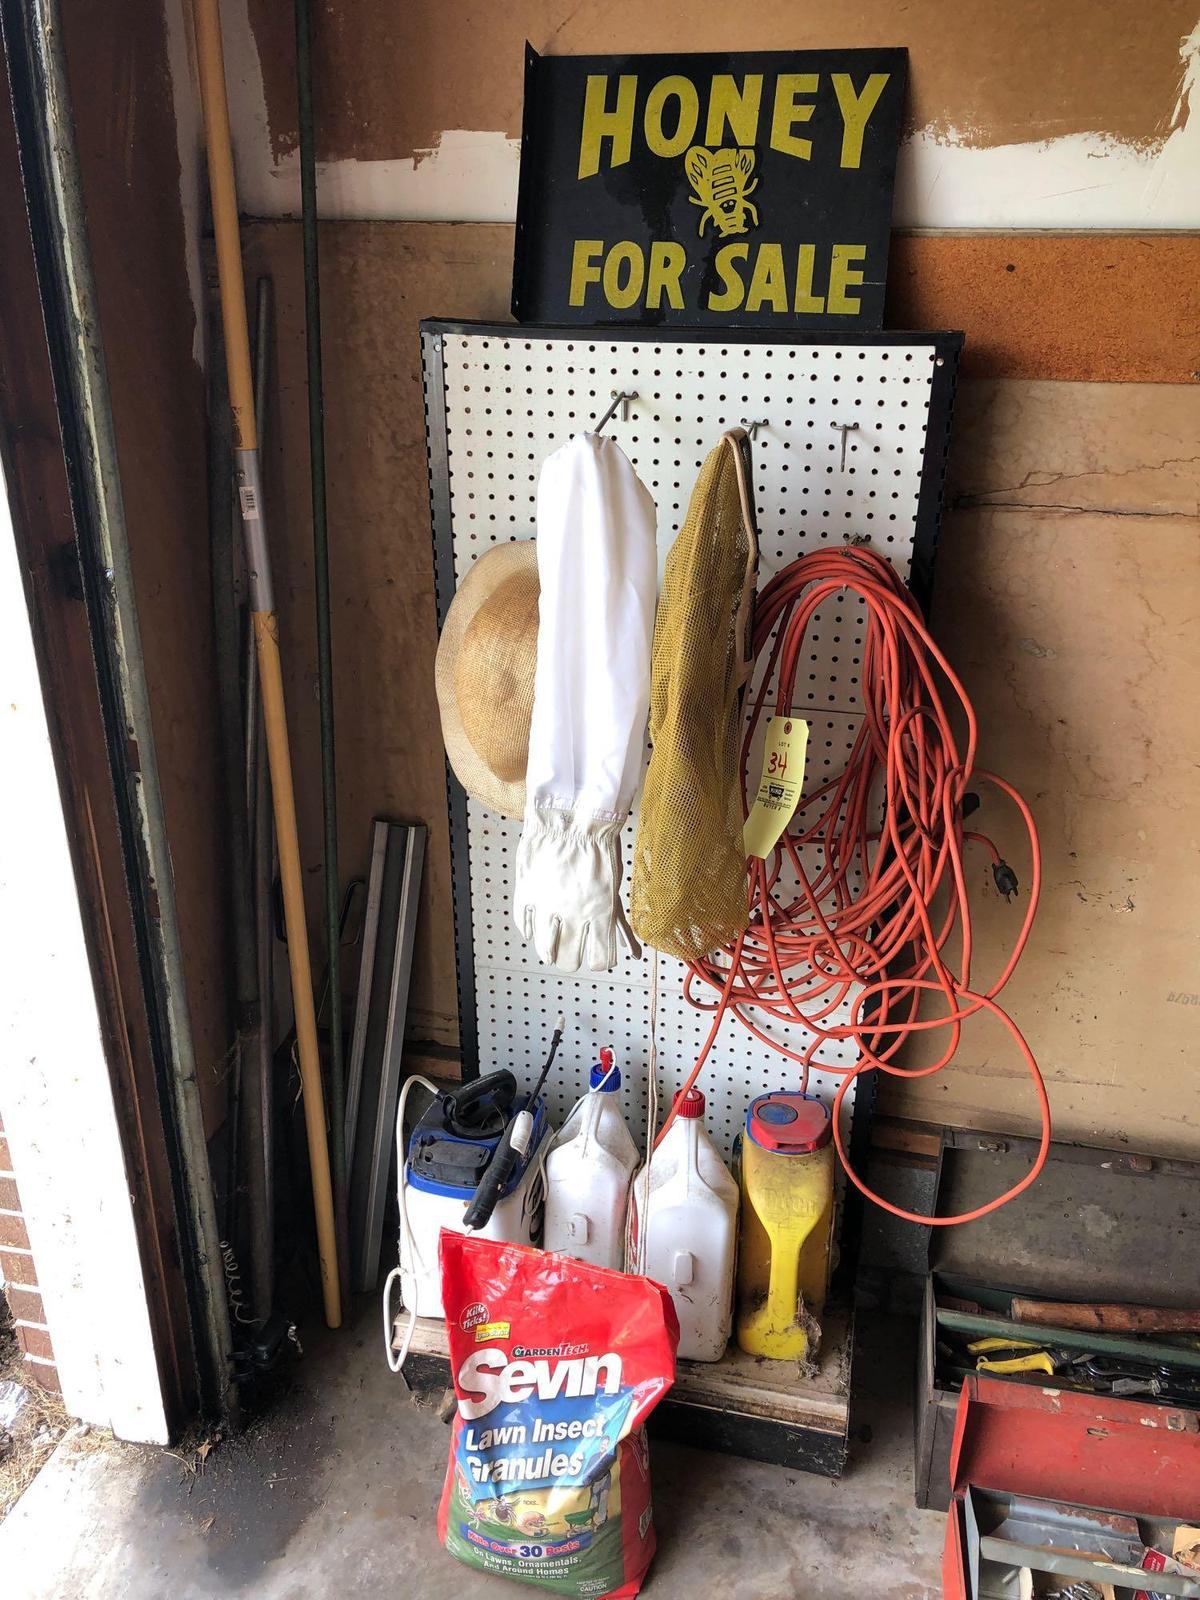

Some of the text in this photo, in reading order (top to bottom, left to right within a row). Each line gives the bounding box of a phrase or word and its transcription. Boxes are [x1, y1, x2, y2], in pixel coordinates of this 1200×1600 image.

[577, 73, 891, 180] HONEY
[568, 240, 866, 315] FOR SALE
[768, 751, 787, 779] 34
[463, 1312, 487, 1330] Ticks!
[467, 1304, 486, 1318] Kills
[458, 1348, 622, 1420] Sevin
[465, 1417, 607, 1451] Lawn Insect
[466, 1448, 584, 1482] Granules
[473, 1546, 484, 1557] On
[519, 1545, 542, 1557] 30
[545, 1541, 580, 1556] Pests
[483, 1560, 500, 1570] And
[502, 1565, 533, 1575] Around
[536, 1566, 569, 1575] Homes
[580, 1583, 607, 1592] CAUTION
